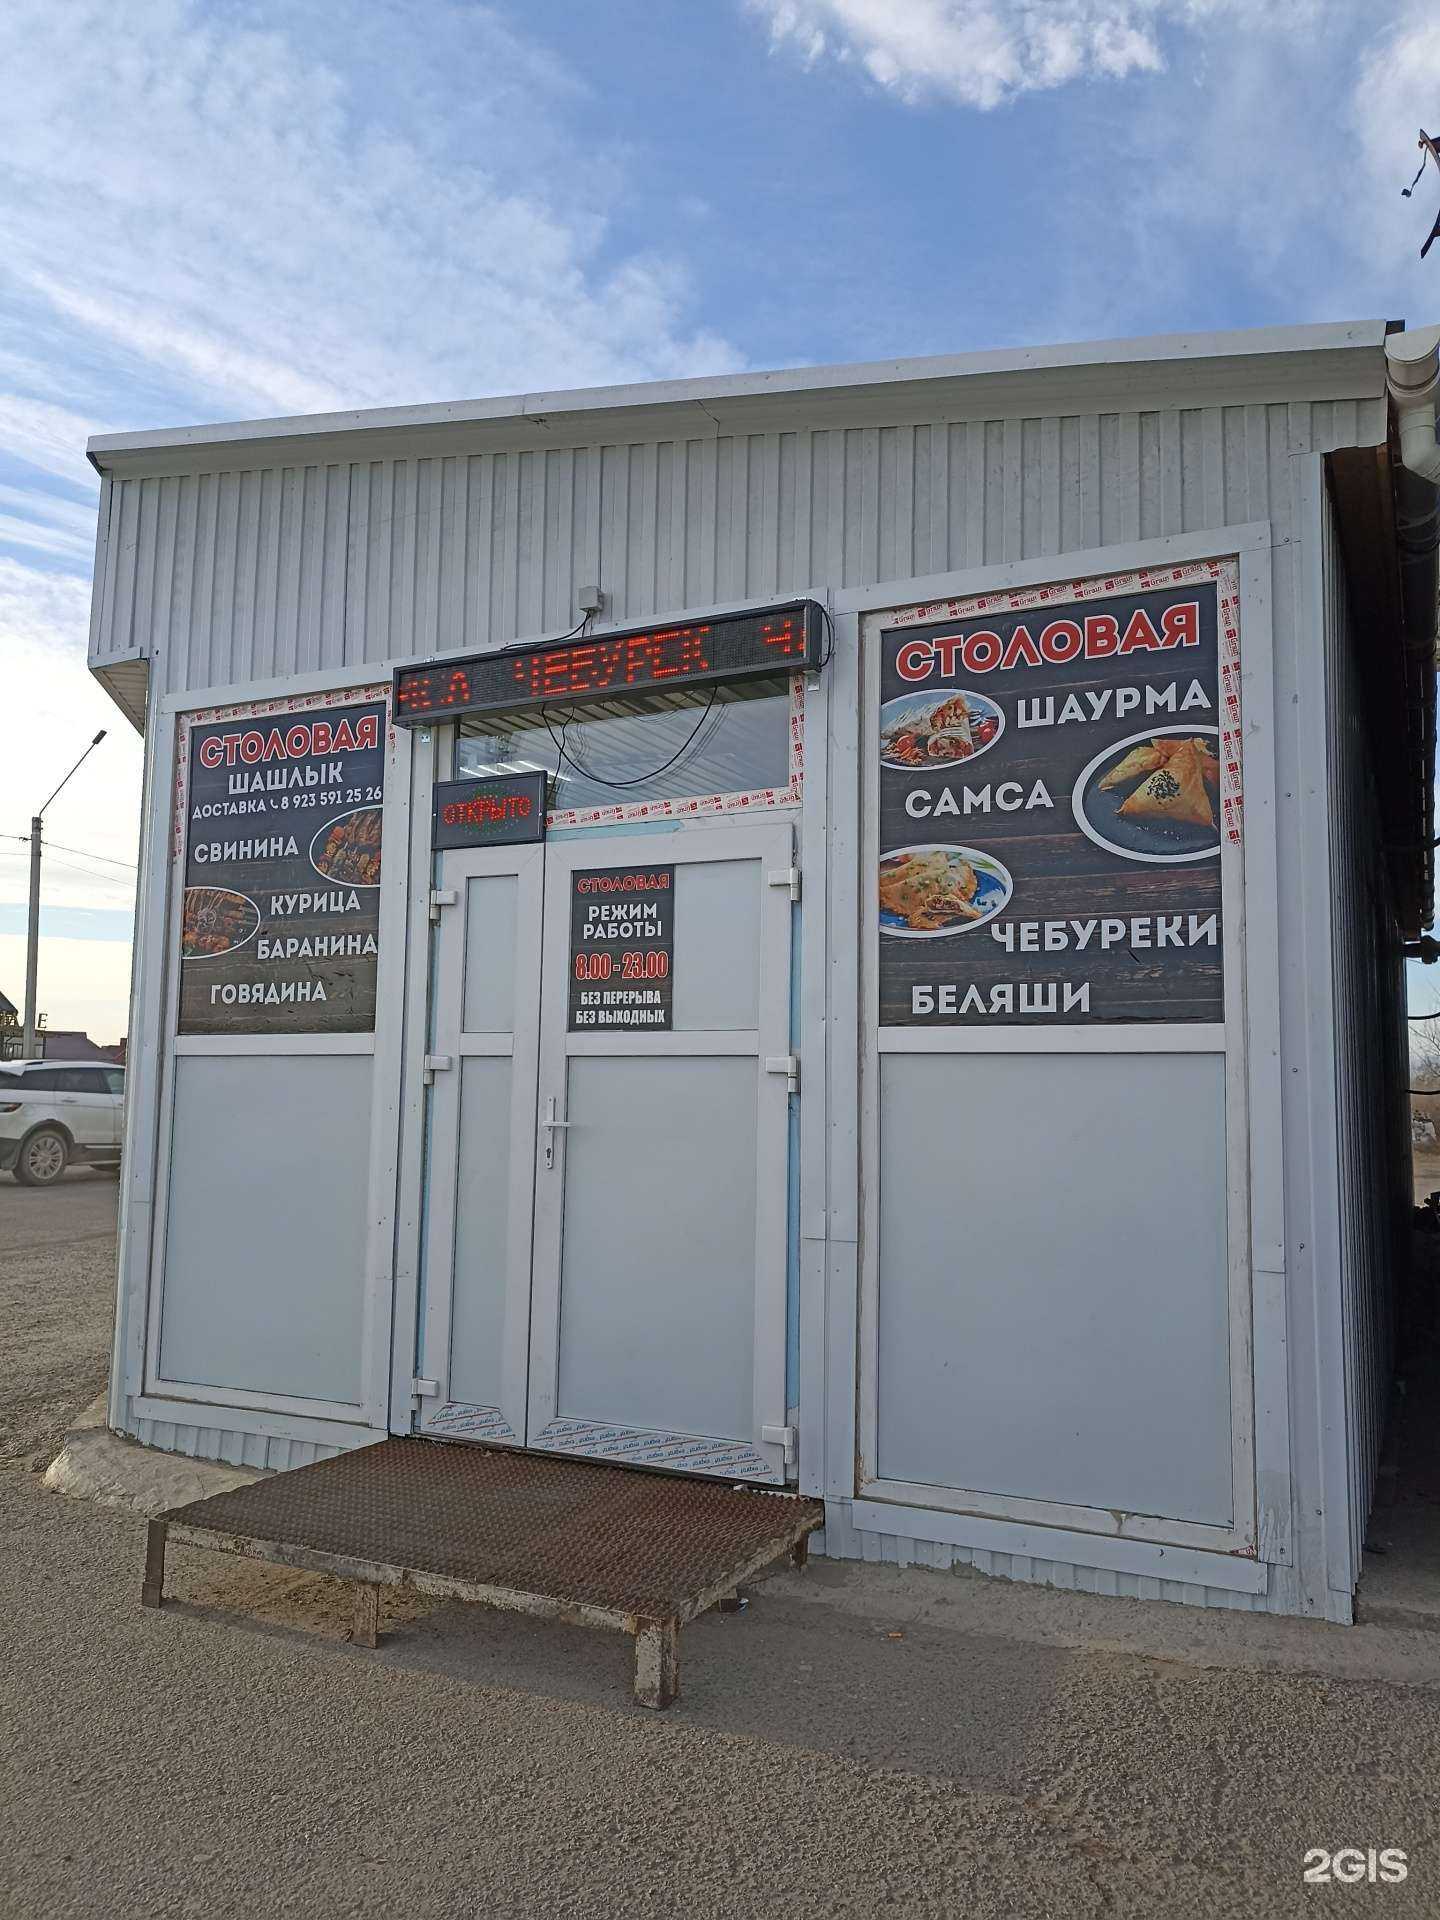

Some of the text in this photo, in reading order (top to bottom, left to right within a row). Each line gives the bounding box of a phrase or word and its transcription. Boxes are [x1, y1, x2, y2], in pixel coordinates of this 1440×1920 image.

[895, 601, 1200, 681] СТОЛОВАЯ
[1016, 678, 1212, 729] ШАУРМА
[199, 714, 379, 768] СТОЛОВАЯ
[228, 761, 343, 795] ШАШЛЫК
[192, 786, 382, 820] ДОСТАВКА 8 923 591 25 26
[443, 796, 531, 824] ОТКРЫТО
[904, 779, 1055, 819] САМСА
[194, 835, 299, 863] СВИНИНА
[577, 873, 670, 894] СТОЛОВАЯ
[270, 890, 361, 915] КУРИЦА
[588, 902, 657, 921] РЕЖИМ
[583, 921, 662, 940] РАБОТЫ
[990, 914, 1217, 953] ЧЕБУРЕКИ
[257, 933, 378, 960] БАРАНИНА
[210, 980, 327, 1005] ГОВЯДИНА
[581, 990, 661, 1005] БЕЗ ПЕРЕРЫВА
[912, 982, 1090, 1015] БЕЛЯШИ
[575, 1009, 665, 1025] БЕЗ ВЫХОДНЫХ
